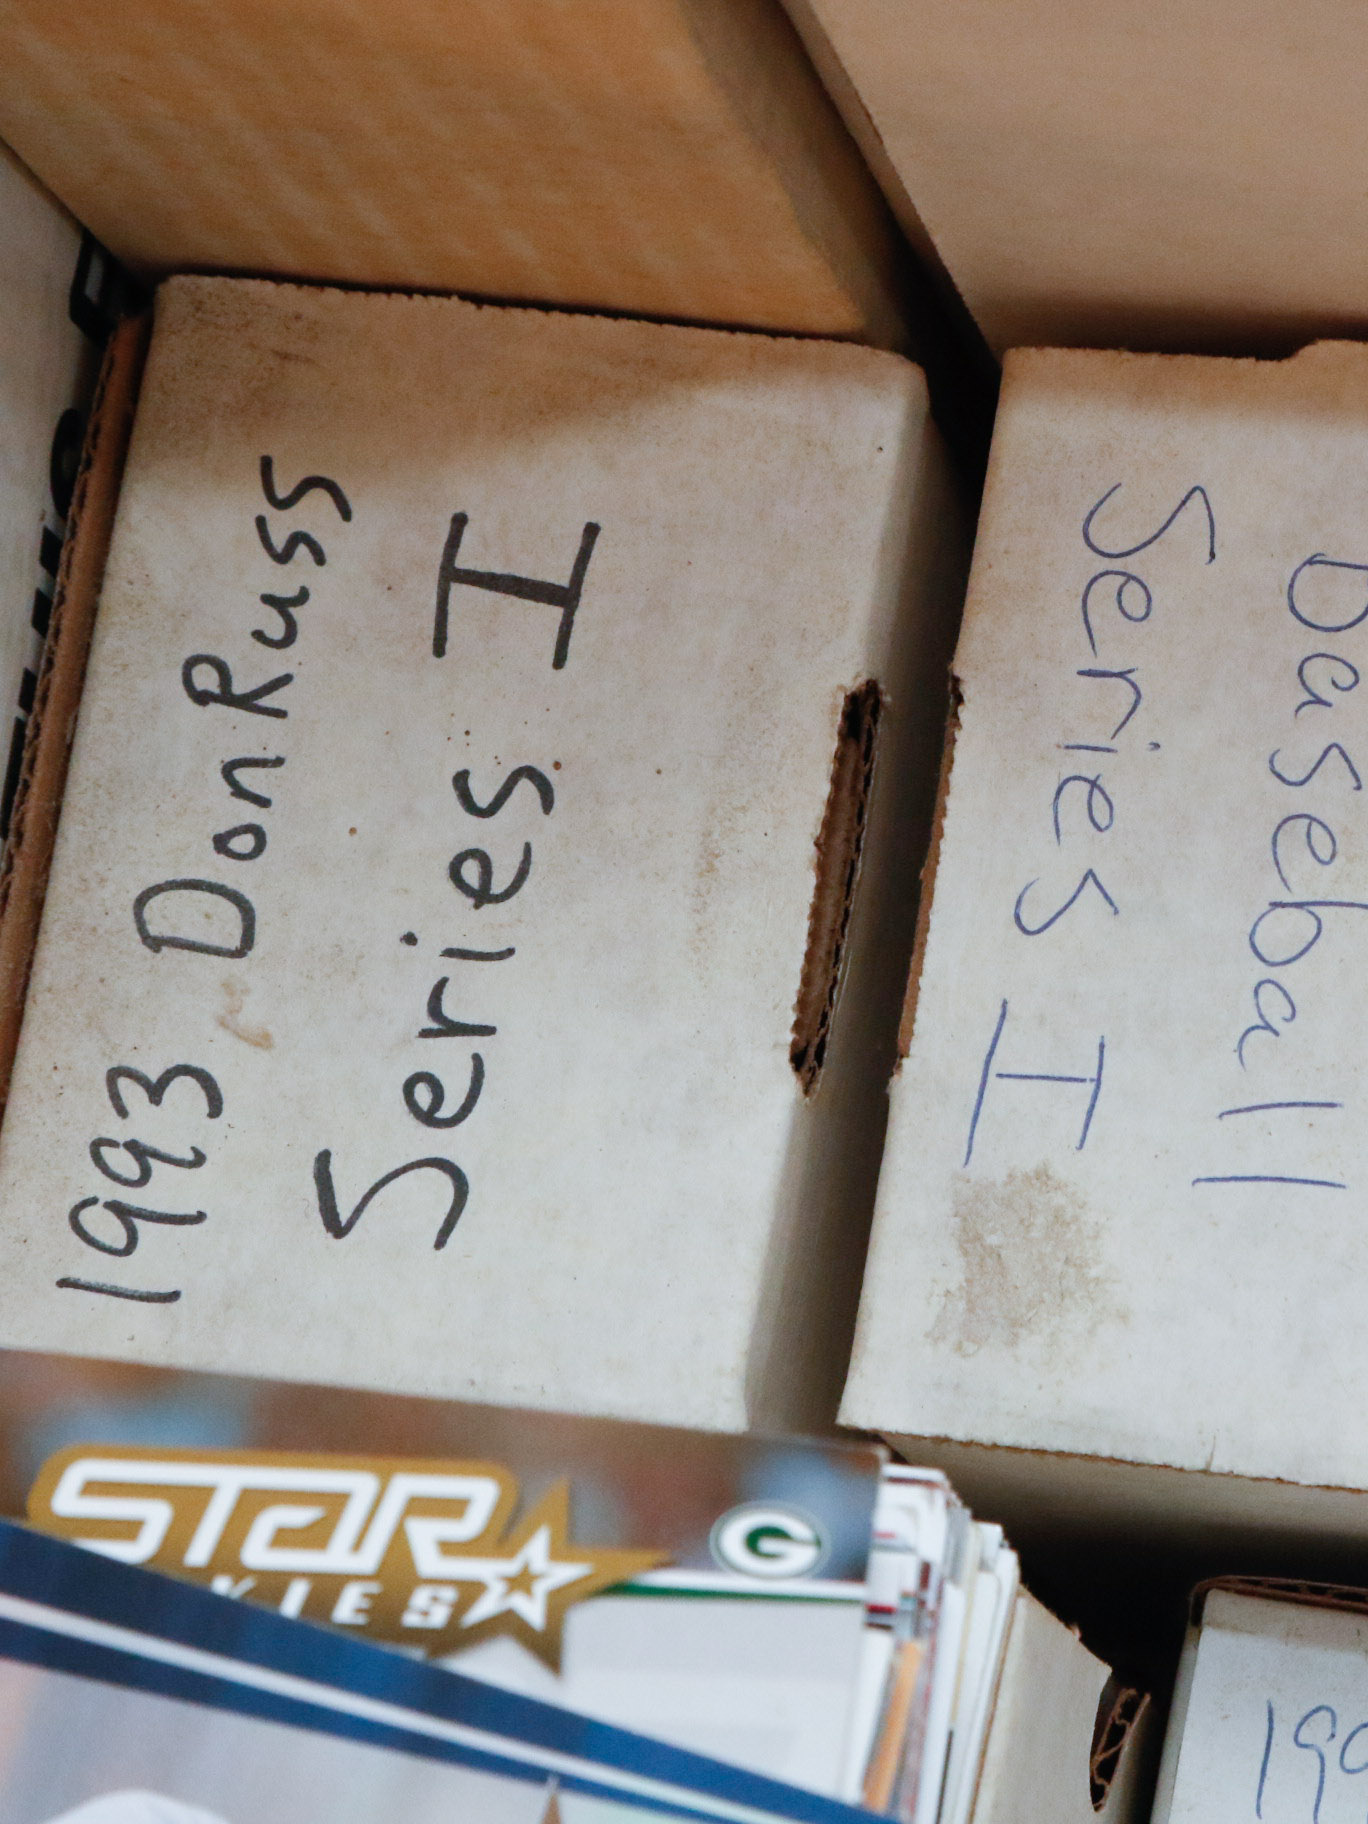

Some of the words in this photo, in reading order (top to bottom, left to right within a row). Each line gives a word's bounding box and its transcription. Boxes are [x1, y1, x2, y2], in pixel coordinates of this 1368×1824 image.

[432, 511, 601, 671] I
[1014, 483, 1216, 936] Series
[313, 760, 562, 1251] Series
[963, 998, 1105, 1168] I
[55, 1064, 224, 1304] 1993
[712, 1506, 824, 1578] G
